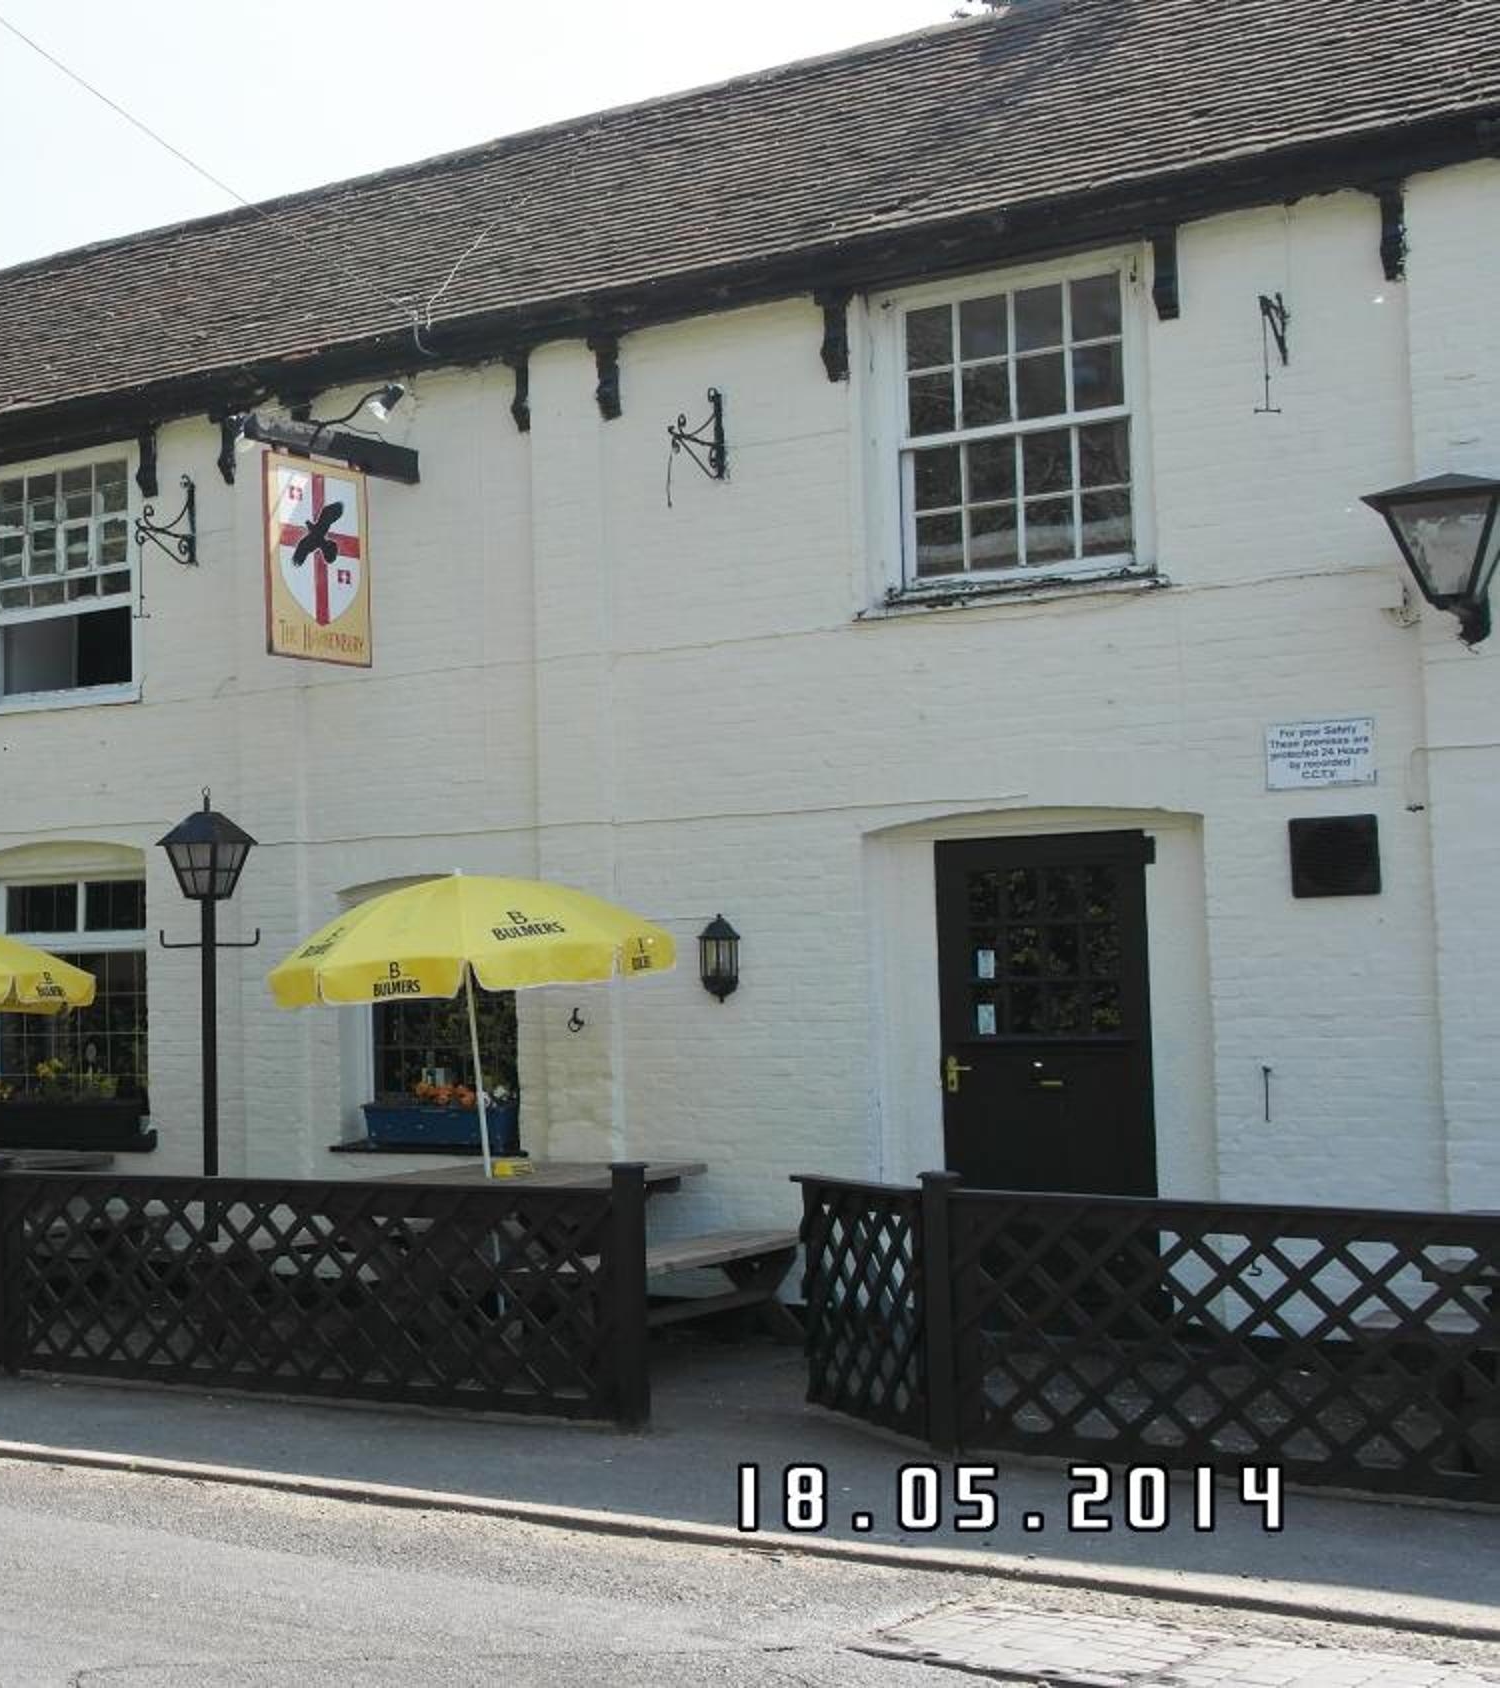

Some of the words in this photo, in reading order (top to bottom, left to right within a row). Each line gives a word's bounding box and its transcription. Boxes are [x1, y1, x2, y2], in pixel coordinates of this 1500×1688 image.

[1321, 747, 1335, 757] 24
[506, 911, 528, 925] B
[492, 922, 566, 941] BULMERS
[389, 962, 400, 979] B
[373, 979, 421, 997] BULMERS
